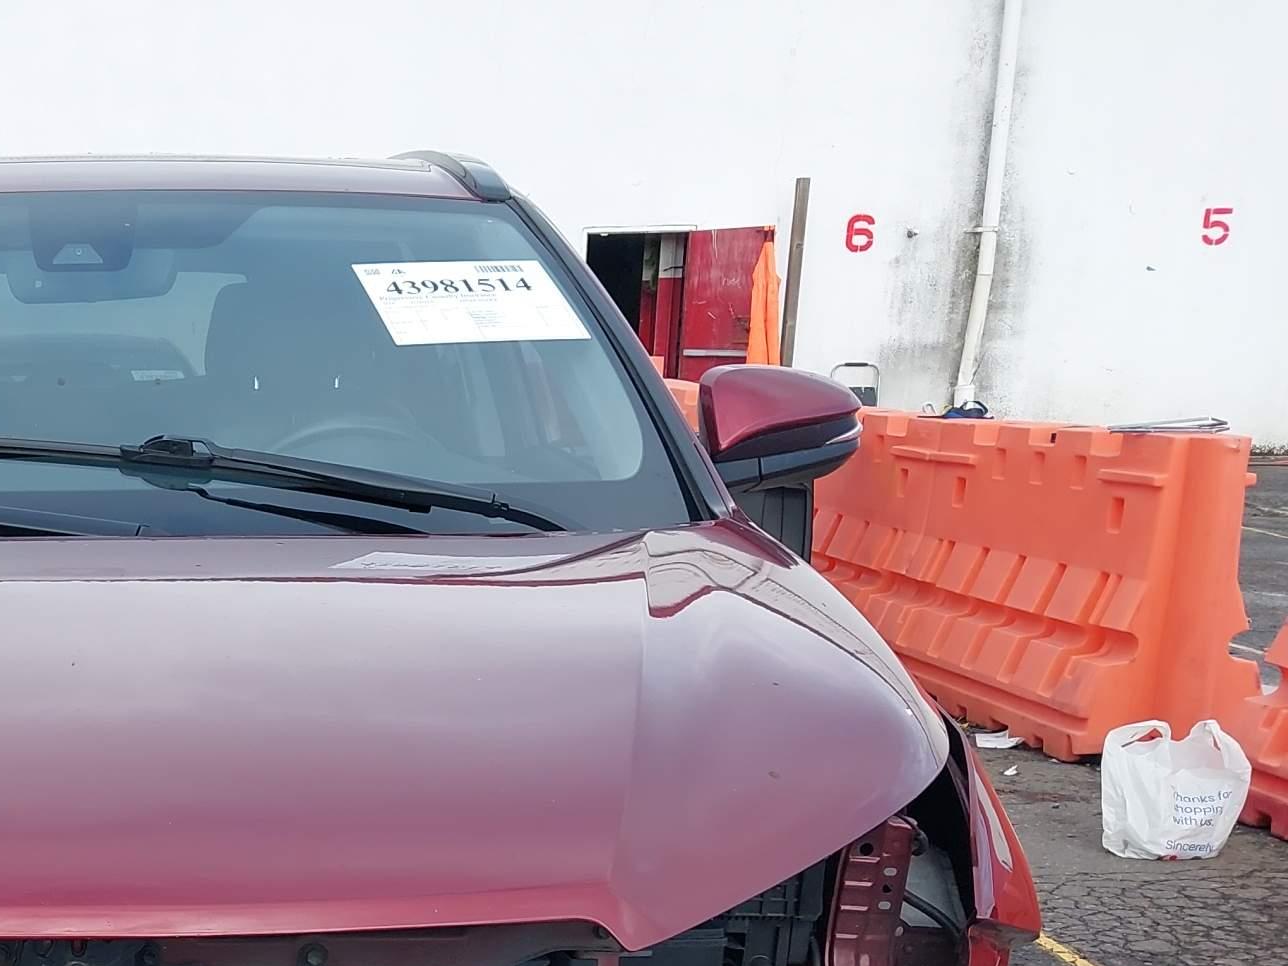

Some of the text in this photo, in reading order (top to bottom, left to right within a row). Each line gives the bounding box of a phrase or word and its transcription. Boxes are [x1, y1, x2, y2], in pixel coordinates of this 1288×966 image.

[845, 213, 875, 253] 6
[1202, 207, 1233, 246] 5
[386, 276, 532, 295] 43981514
[1218, 790, 1232, 800] for
